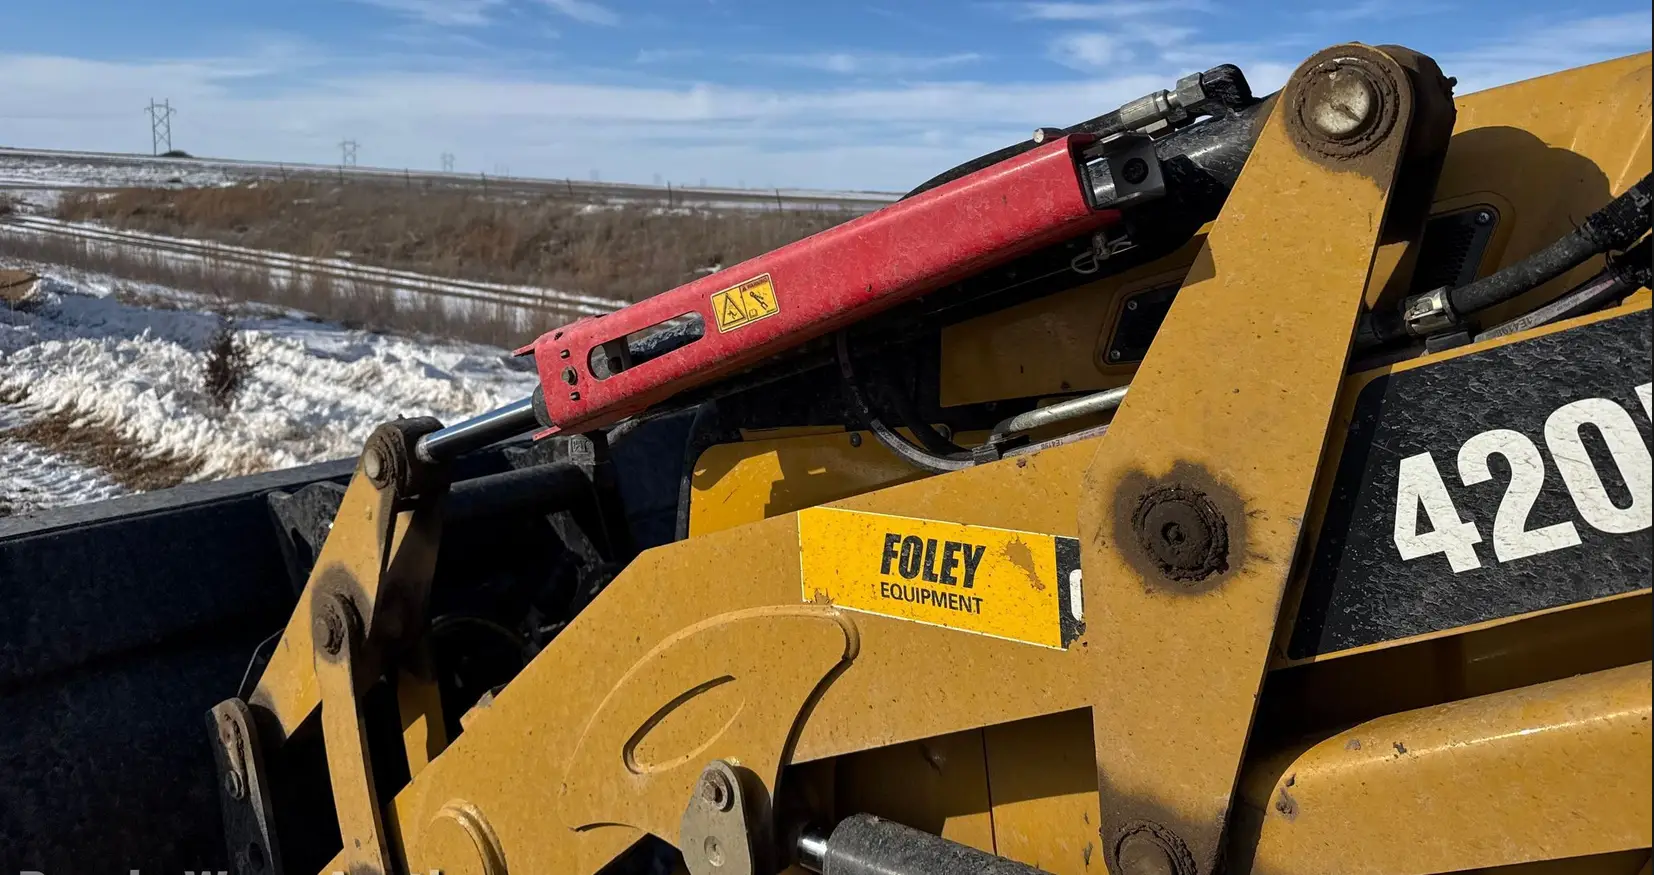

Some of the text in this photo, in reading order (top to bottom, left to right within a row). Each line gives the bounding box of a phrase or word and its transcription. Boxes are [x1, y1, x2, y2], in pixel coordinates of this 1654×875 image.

[1394, 382, 1653, 573] 420
[880, 533, 986, 589] FOLEY
[881, 582, 984, 614] EQUIPMENT
